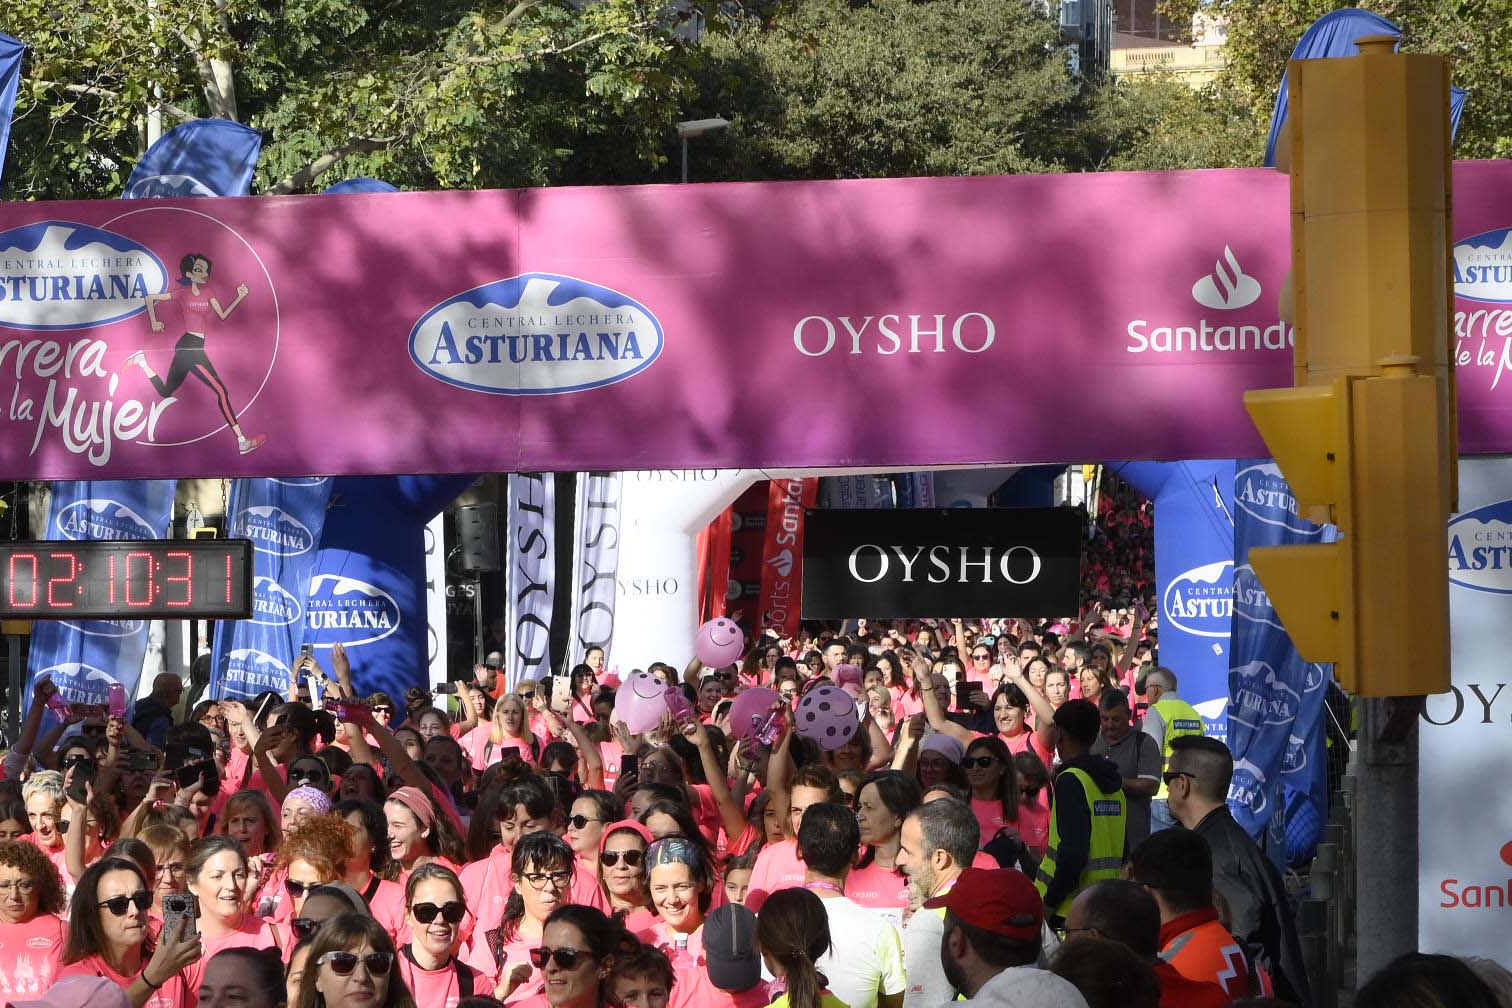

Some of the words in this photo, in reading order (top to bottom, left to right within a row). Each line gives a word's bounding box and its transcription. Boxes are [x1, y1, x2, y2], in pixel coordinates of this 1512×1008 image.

[71, 257, 143, 269] LECHERA
[468, 314, 548, 329] CENTRAL
[553, 312, 635, 327] LECHERA
[793, 312, 996, 357] OYSHO
[429, 321, 644, 365] ASTURIANA
[1477, 338, 1495, 366] la
[9, 381, 34, 421] la
[29, 373, 178, 466] Mujer
[9, 552, 233, 607] 02:10:31
[848, 544, 1041, 584] OYSHO
[338, 599, 387, 608] LECHERA
